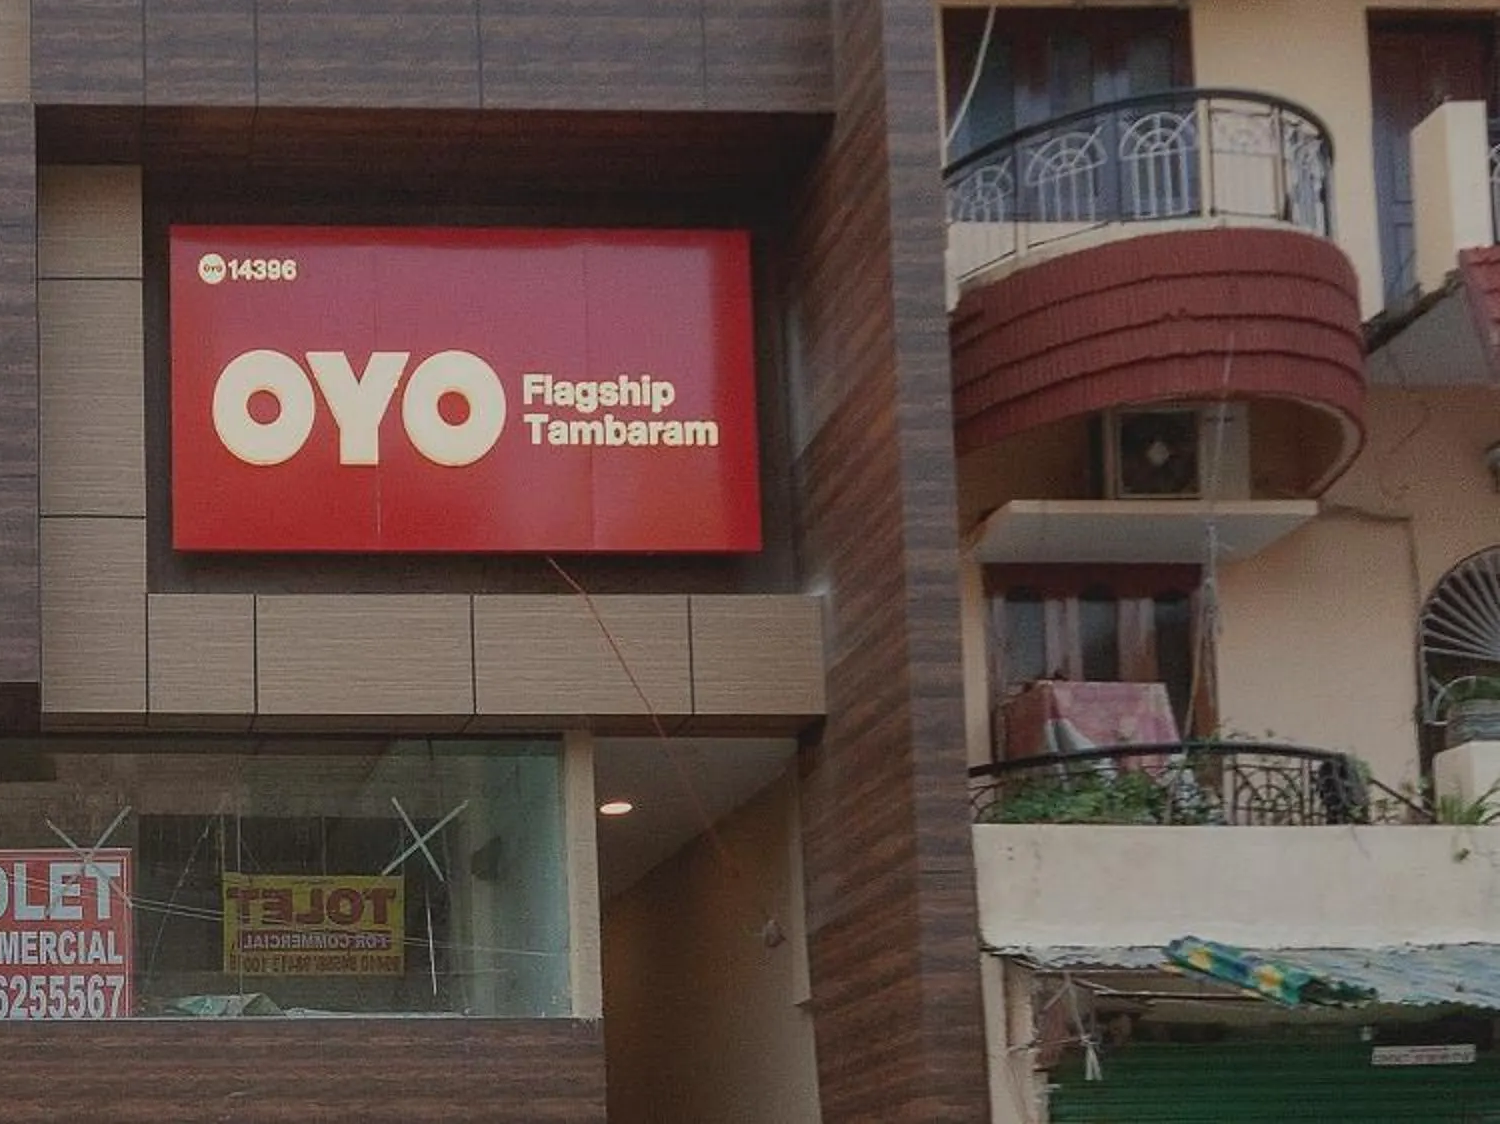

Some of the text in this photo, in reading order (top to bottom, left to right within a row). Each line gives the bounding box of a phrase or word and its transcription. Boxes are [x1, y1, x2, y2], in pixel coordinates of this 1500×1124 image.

[212, 349, 507, 467] OYO
[522, 374, 675, 413] Flagship
[523, 413, 719, 447] Tambaram
